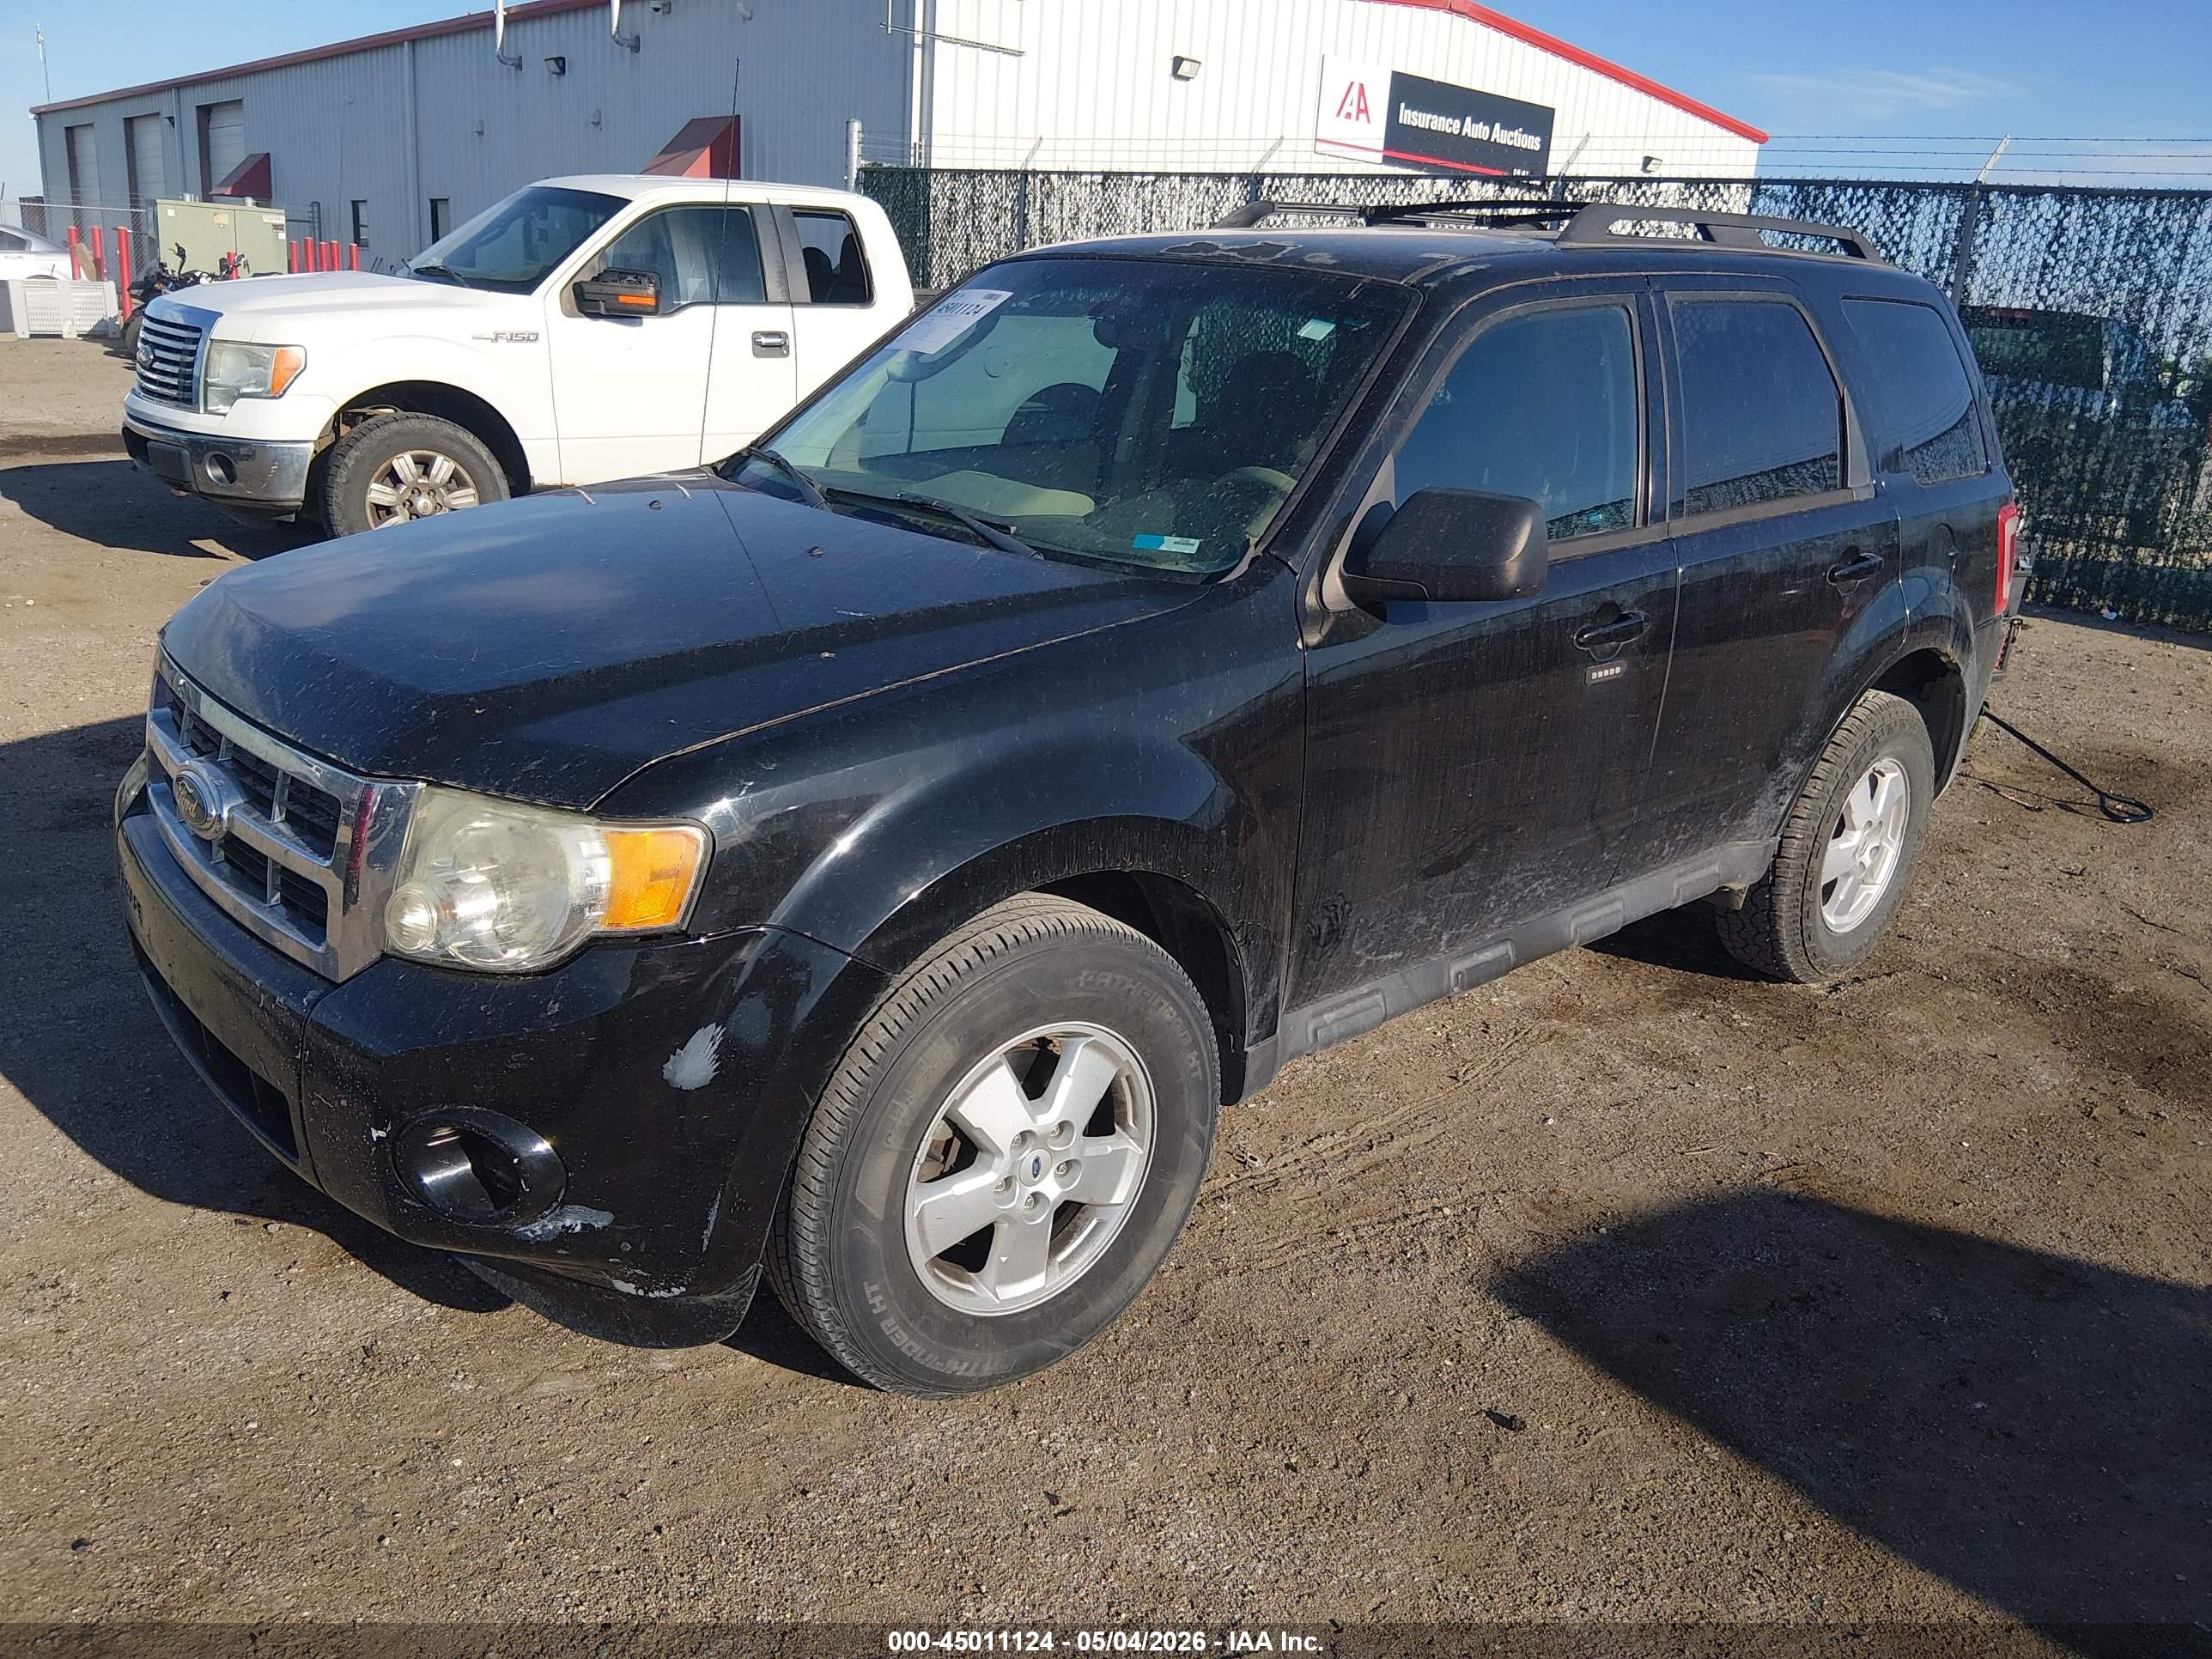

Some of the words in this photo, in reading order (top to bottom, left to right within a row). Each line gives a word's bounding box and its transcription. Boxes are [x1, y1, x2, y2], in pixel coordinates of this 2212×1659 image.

[1398, 102, 1461, 135] Insurance
[1462, 116, 1490, 141] Auto
[1491, 123, 1541, 151] Auctions
[177, 780, 198, 818] Ford
[862, 1281, 888, 1315] HT
